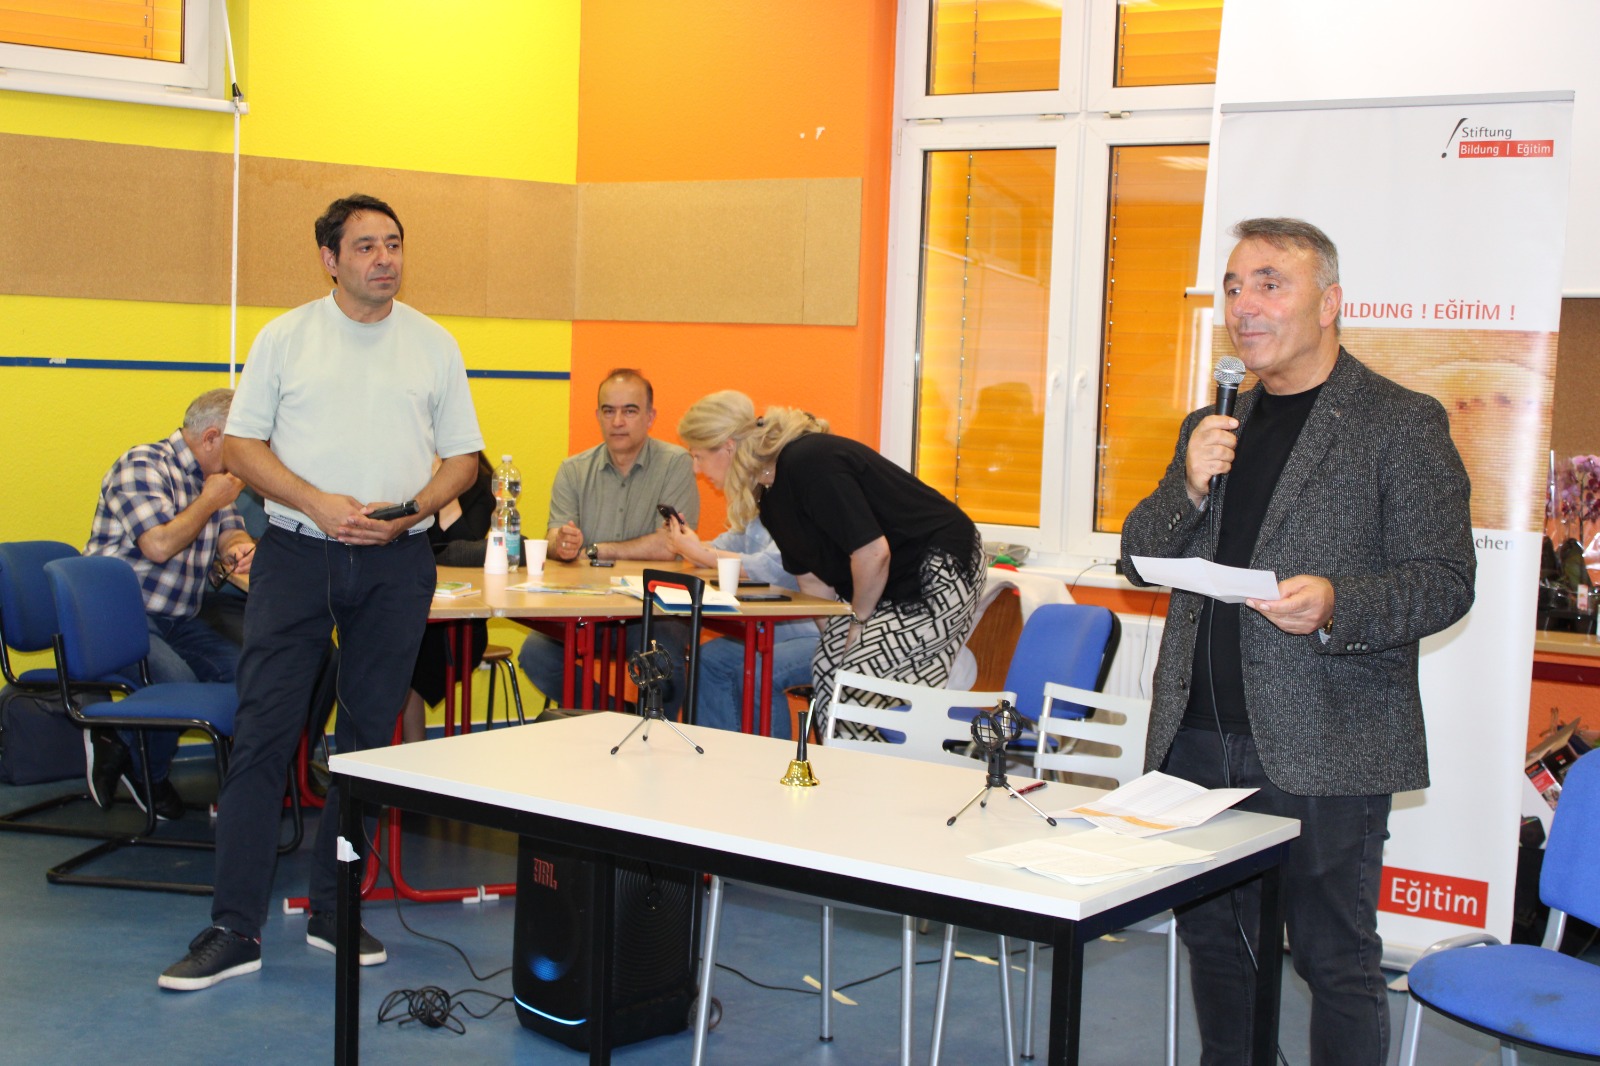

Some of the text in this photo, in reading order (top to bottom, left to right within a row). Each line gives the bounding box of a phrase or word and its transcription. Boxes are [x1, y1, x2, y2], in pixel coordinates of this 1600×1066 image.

[1461, 126, 1512, 140] Stiftung
[1460, 144, 1500, 157] Bildung
[1516, 143, 1551, 157] Eğitim
[1342, 302, 1413, 320] ILDUNG
[1433, 298, 1501, 321] EĞİTİM
[1475, 534, 1514, 551] chen
[1390, 876, 1479, 917] Eğitim
